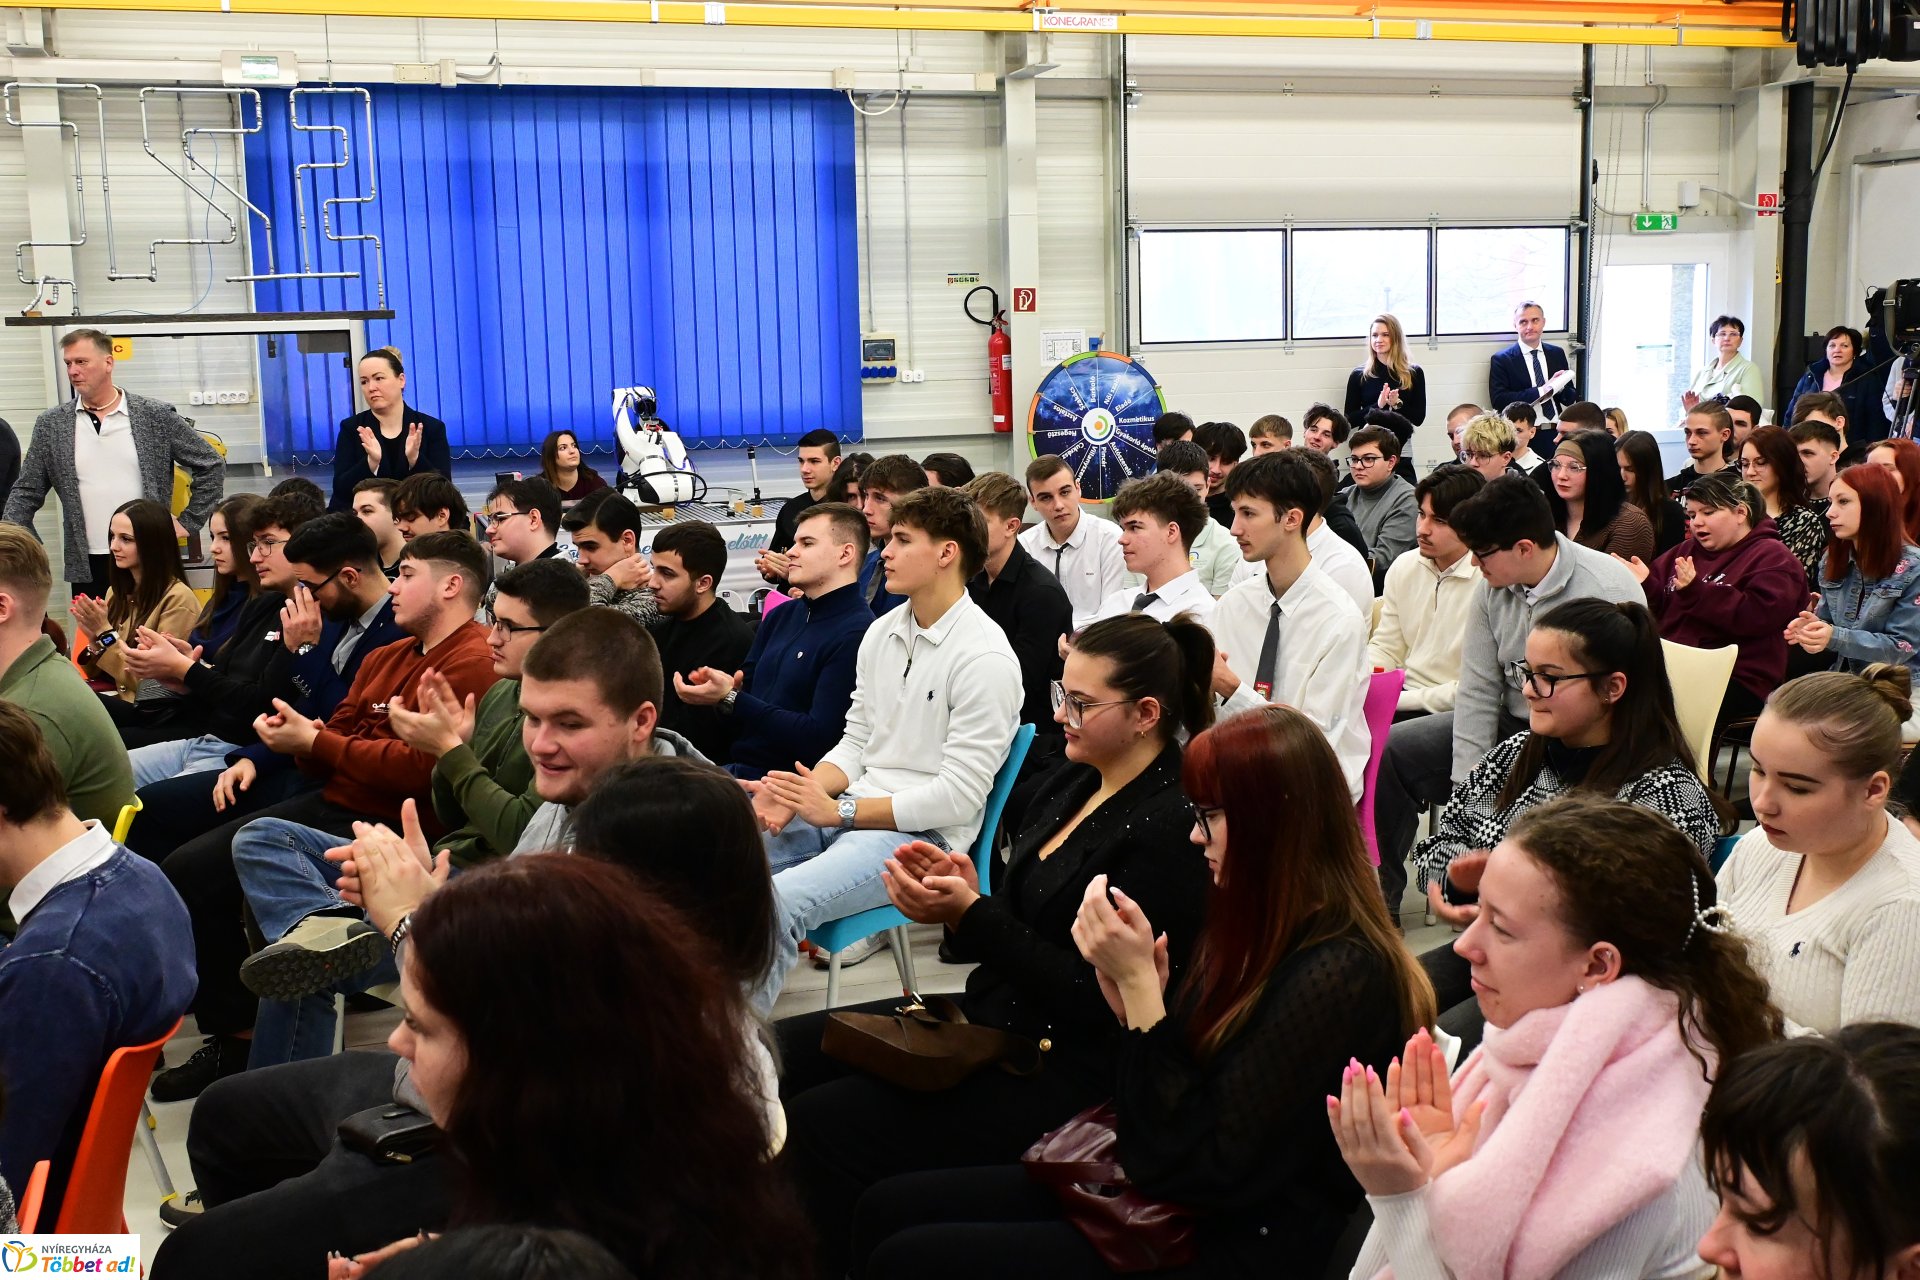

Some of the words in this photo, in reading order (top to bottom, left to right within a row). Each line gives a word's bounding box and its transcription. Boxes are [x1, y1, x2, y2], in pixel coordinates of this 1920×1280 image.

[1043, 16, 1114, 27] KONECRANES
[1052, 404, 1078, 422] Asztalos
[1115, 428, 1141, 446] Gyakorló
[1061, 442, 1085, 460] Cukrász
[1075, 446, 1098, 483] Villanyszere
